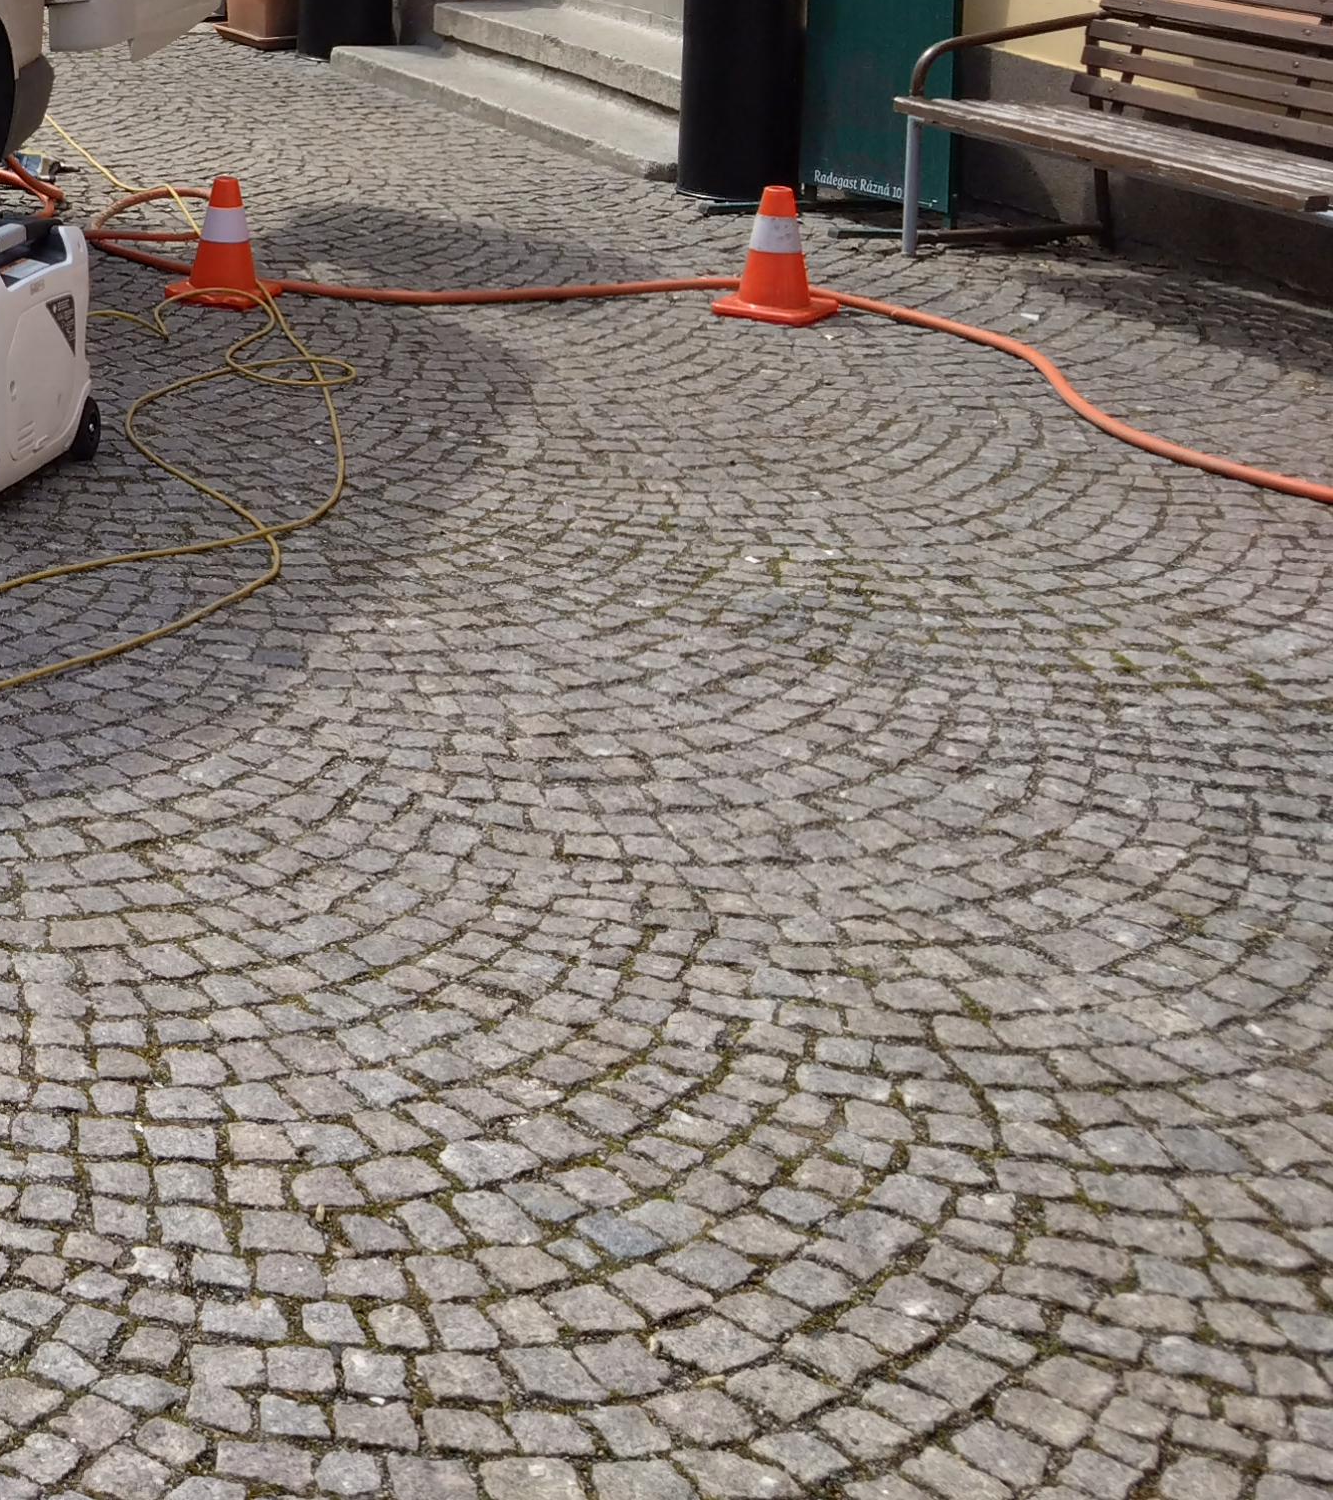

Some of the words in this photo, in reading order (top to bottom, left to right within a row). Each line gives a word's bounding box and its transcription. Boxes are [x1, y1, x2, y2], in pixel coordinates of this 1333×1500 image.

[813, 169, 858, 191] Radegast
[859, 178, 890, 196] Rázná
[892, 185, 903, 199] 10
